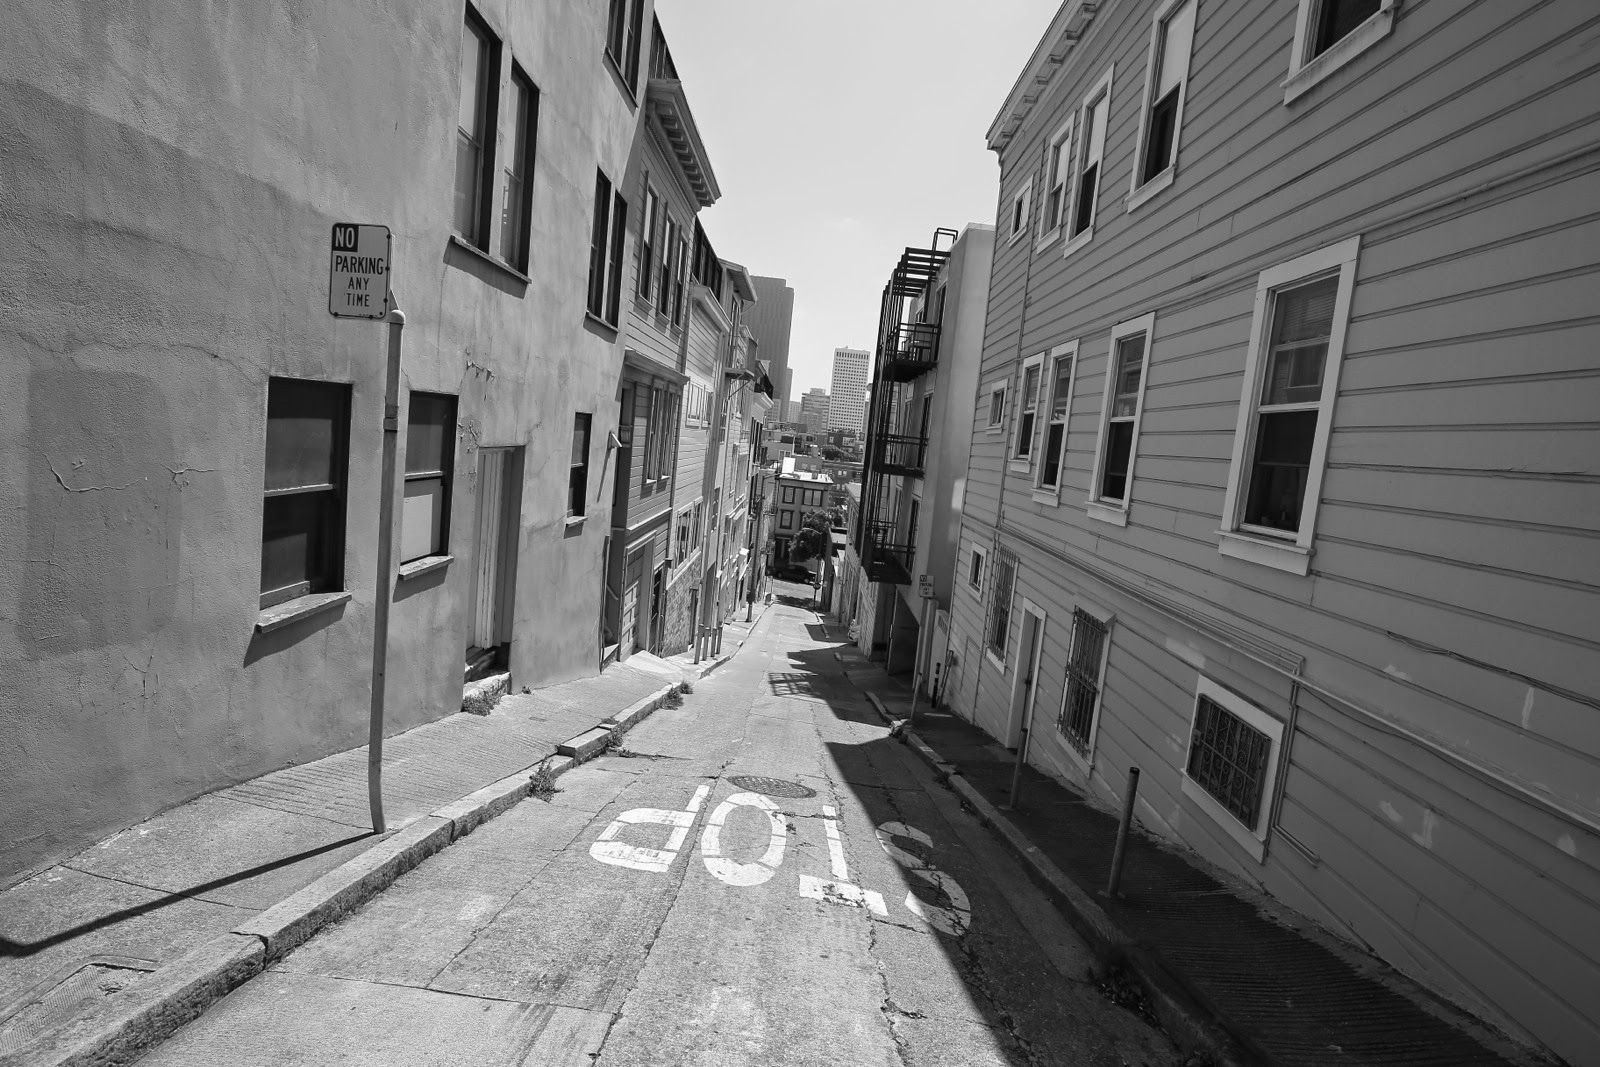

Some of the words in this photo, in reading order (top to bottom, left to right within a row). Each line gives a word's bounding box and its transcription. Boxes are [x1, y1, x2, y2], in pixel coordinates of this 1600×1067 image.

[335, 227, 355, 248] NO
[335, 255, 384, 275] PARKING
[347, 277, 370, 291] ANY
[346, 293, 370, 307] TIME
[589, 785, 971, 936] STOP
